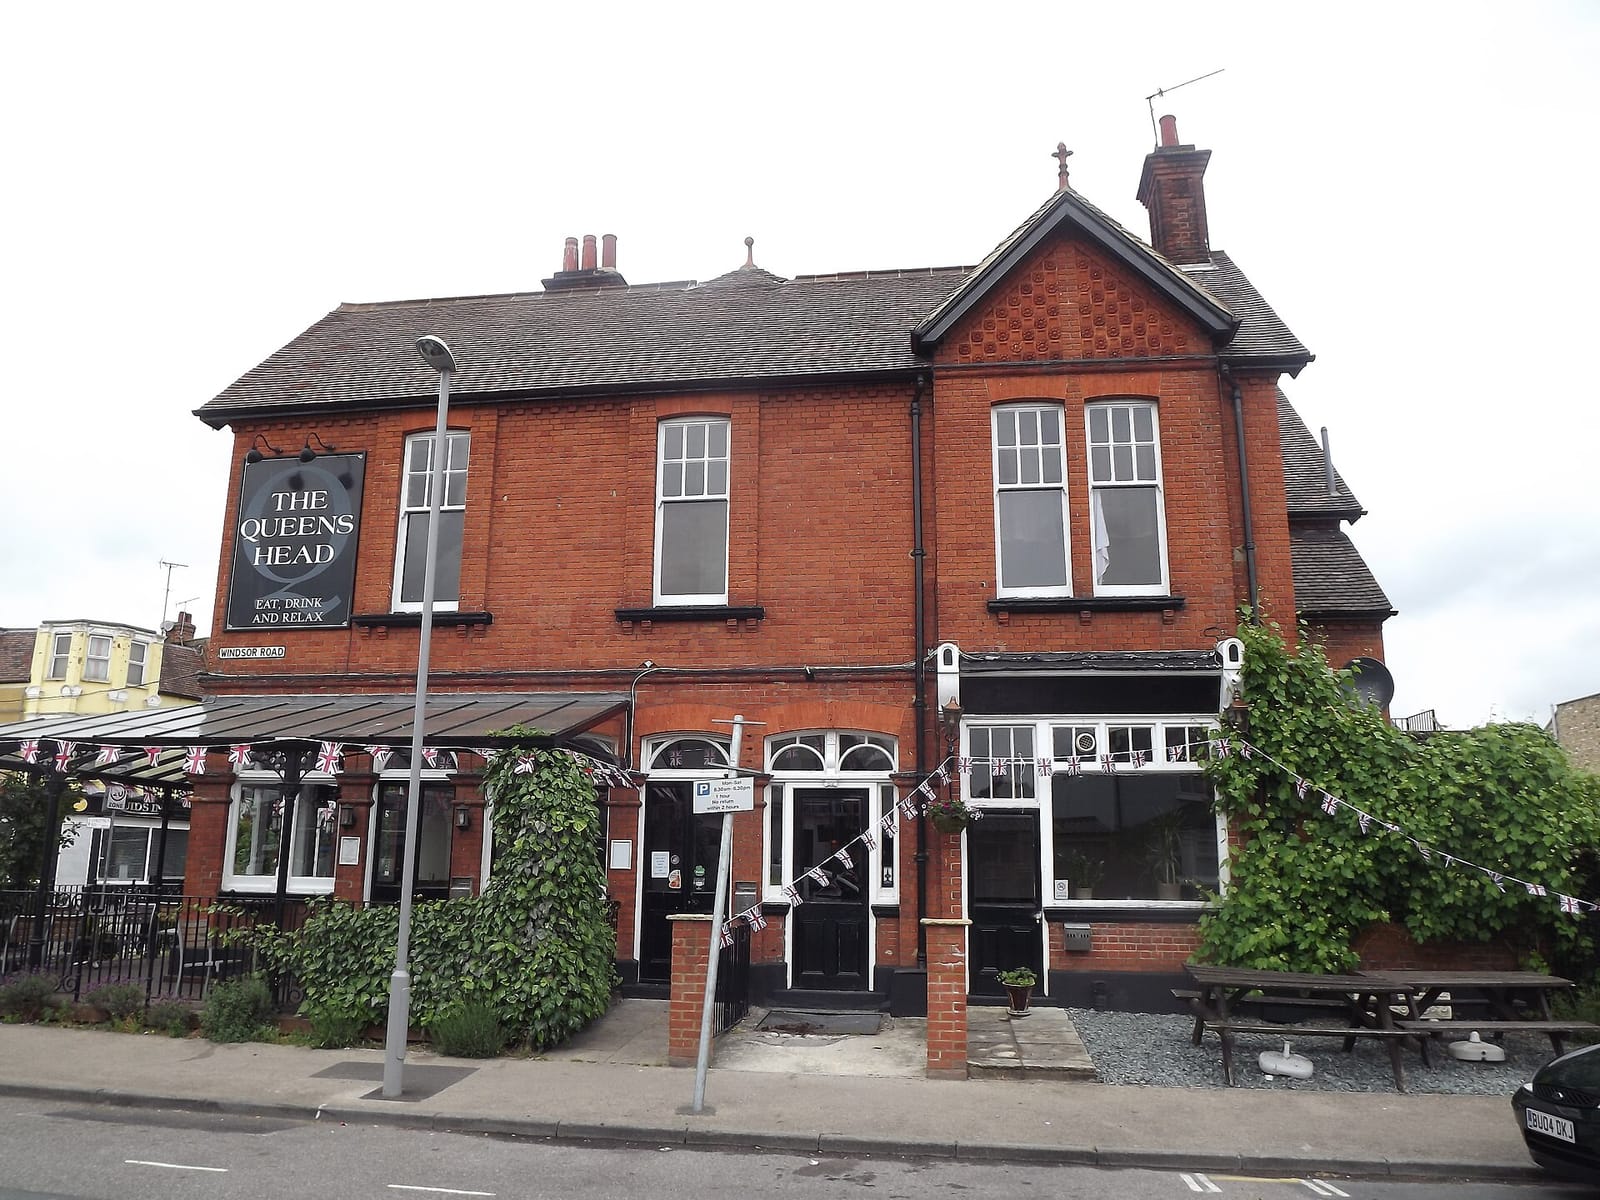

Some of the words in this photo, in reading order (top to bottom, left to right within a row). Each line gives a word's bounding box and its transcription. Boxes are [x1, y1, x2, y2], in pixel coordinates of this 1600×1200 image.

[271, 490, 328, 512] THE
[240, 514, 354, 543] QUEENS
[253, 544, 335, 566] HEAD
[255, 599, 281, 610] EAT,
[284, 597, 322, 609] DRINK
[251, 613, 279, 624] AND
[282, 611, 323, 623] RELAX
[220, 648, 257, 658] WINDSOR
[259, 647, 284, 657] ROAD
[700, 784, 709, 795] P
[1556, 1120, 1573, 1140] DKJ
